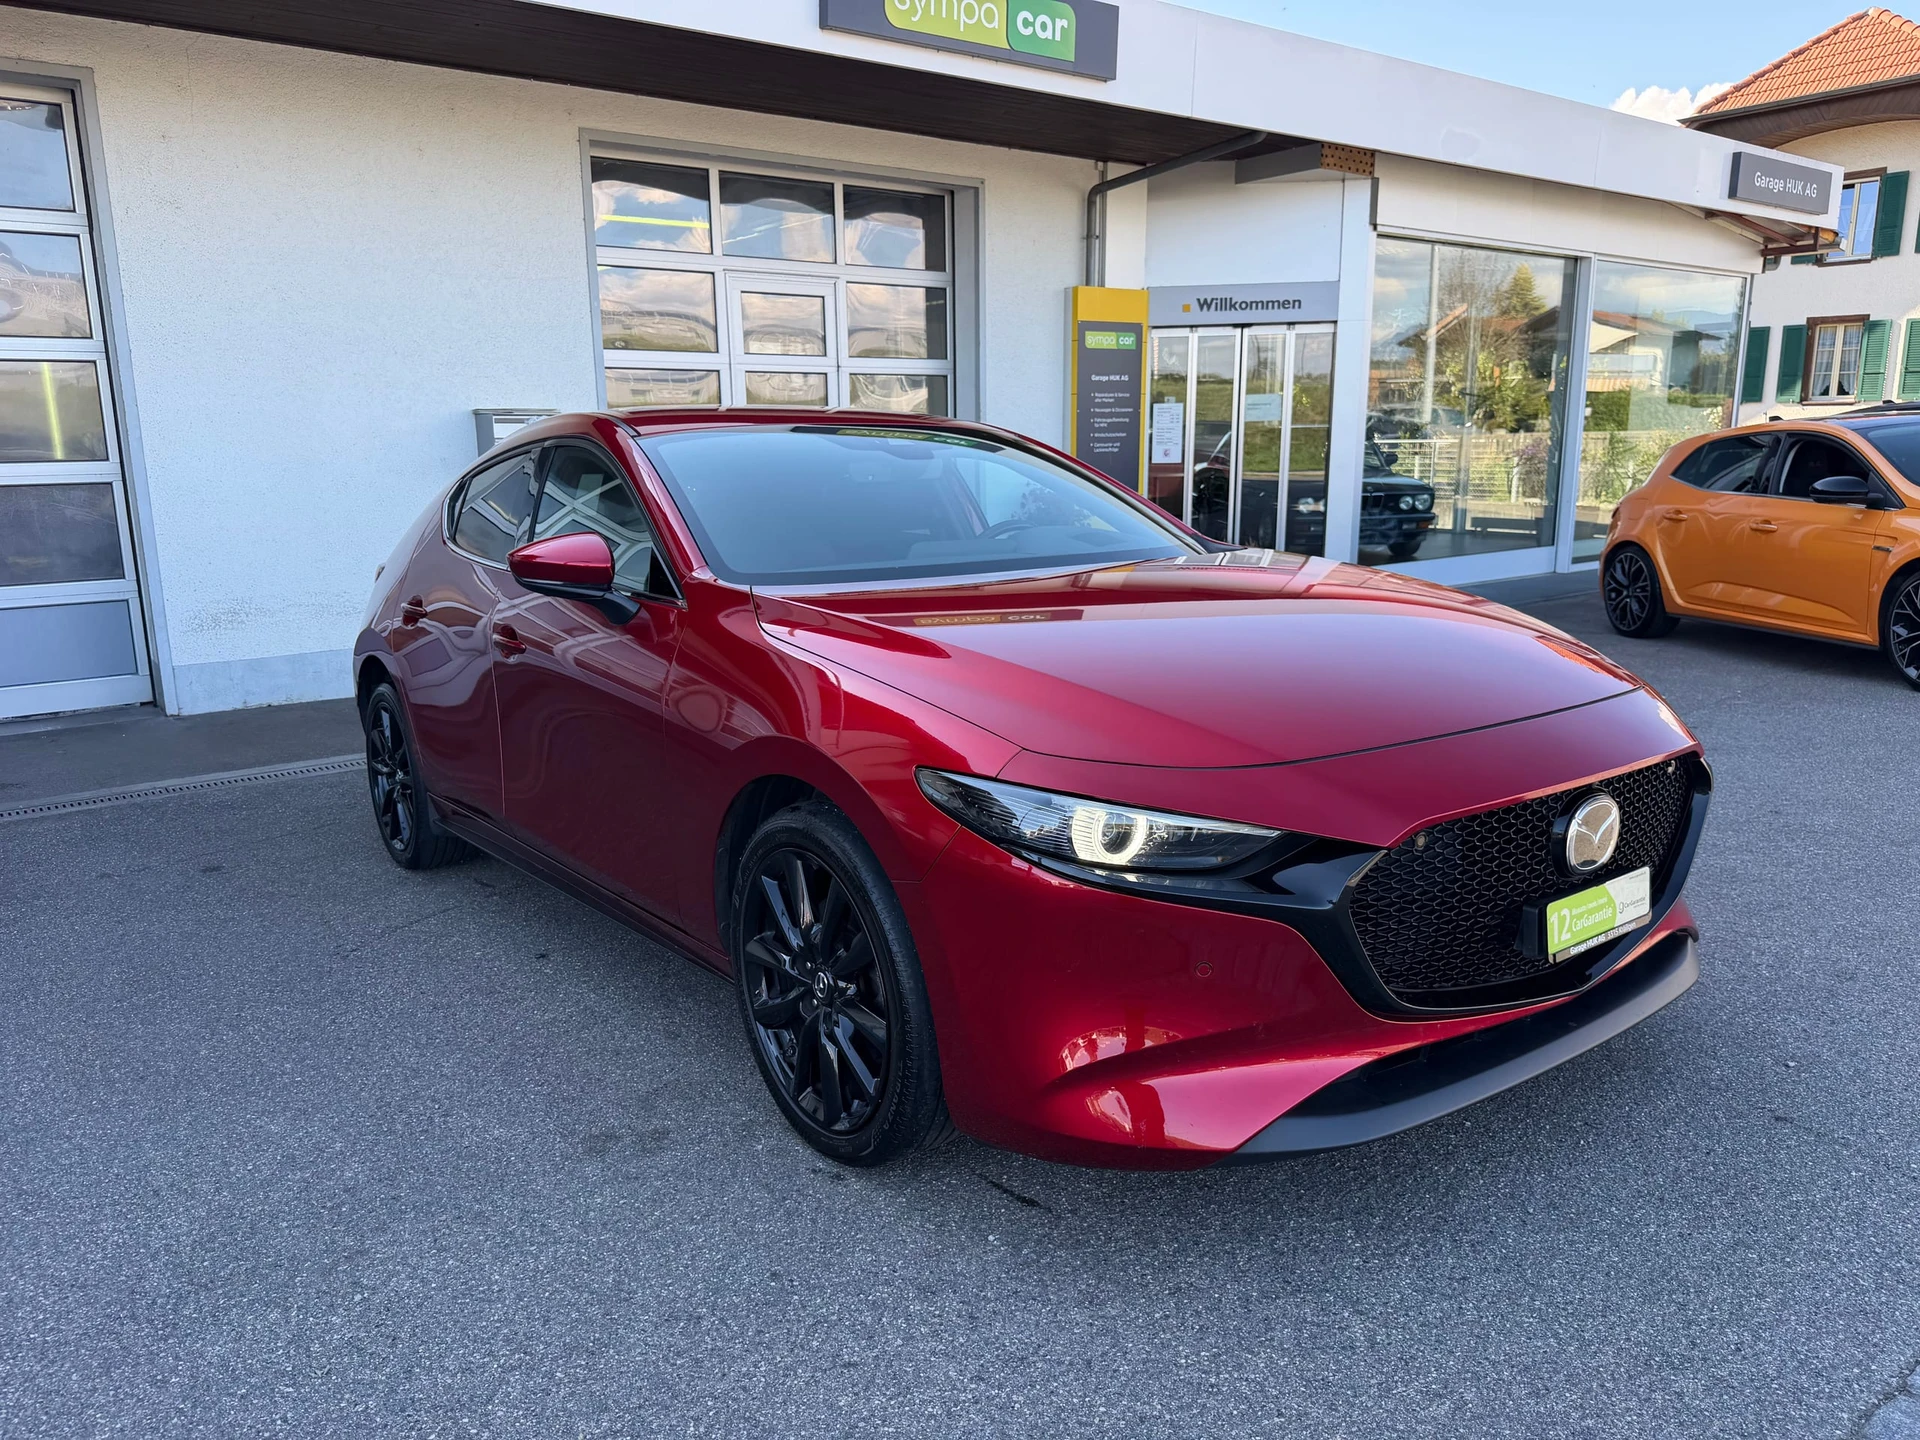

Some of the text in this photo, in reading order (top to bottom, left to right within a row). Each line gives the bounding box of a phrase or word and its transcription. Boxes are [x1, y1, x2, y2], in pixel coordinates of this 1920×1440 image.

[1016, 10, 1068, 42] car
[1754, 171, 1818, 198] Garage HUK AG
[1196, 297, 1302, 313] Willkommen
[1087, 335, 1134, 347] sympa car
[1091, 374, 1109, 382] Garage
[1550, 908, 1571, 944] 12
[1571, 904, 1613, 931] CarGarantie
